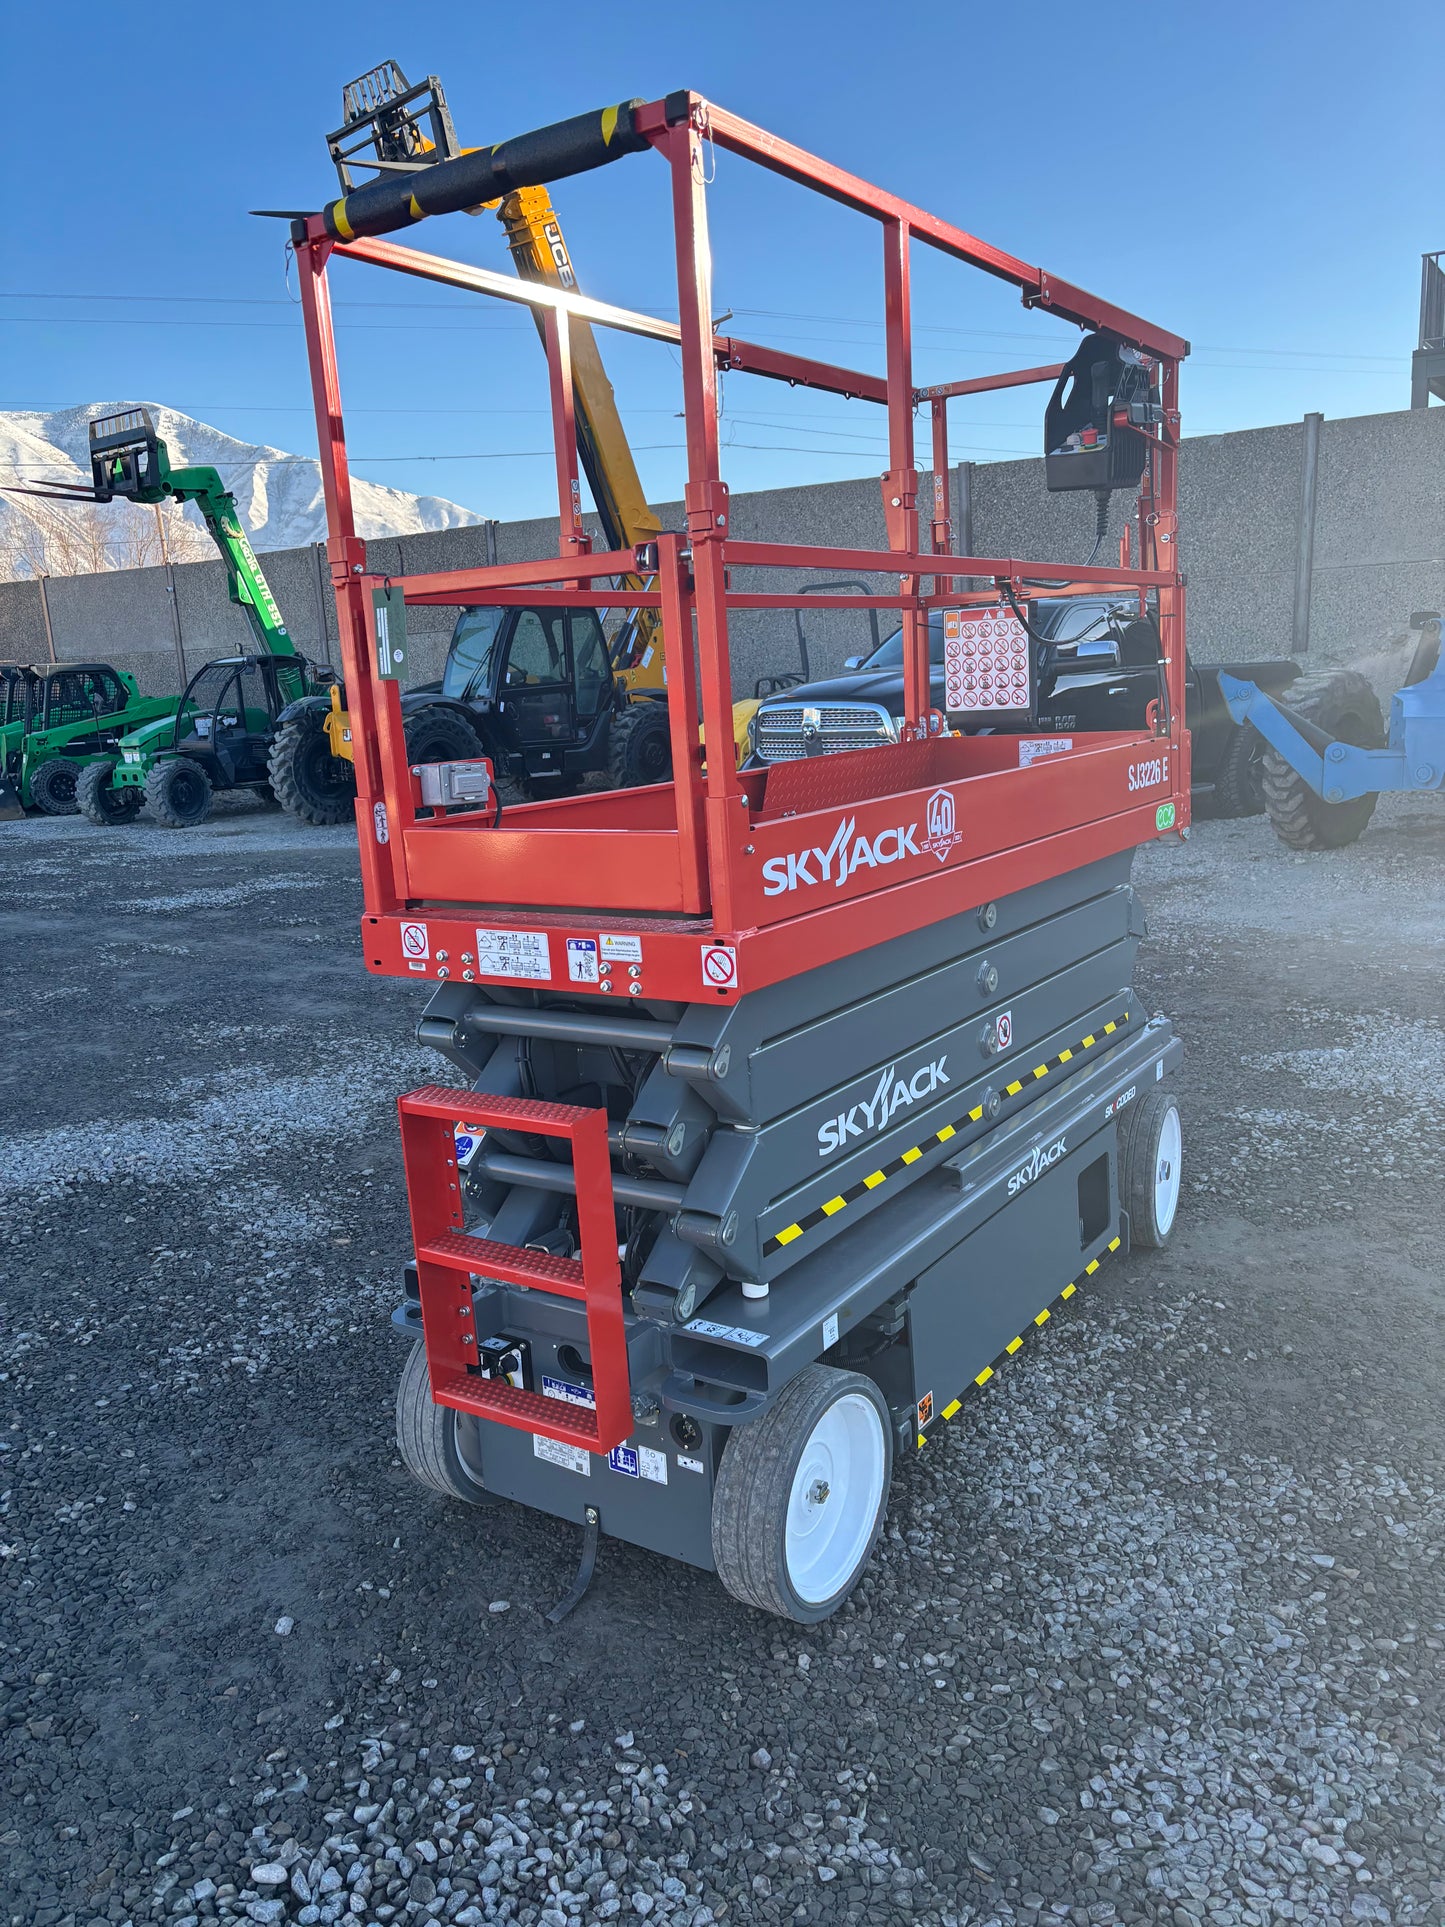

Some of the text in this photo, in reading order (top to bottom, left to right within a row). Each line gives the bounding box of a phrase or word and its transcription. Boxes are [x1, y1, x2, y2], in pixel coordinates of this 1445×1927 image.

[544, 223, 574, 289] JCB
[239, 538, 259, 573] Genie
[254, 574, 273, 601] GTH
[1128, 756, 1168, 792] SJ3226 E
[931, 798, 952, 837] 40
[762, 815, 921, 896] SKYJACK
[817, 1055, 951, 1156] SKYJACK
[1007, 1136, 1067, 1196] SKYJACK
